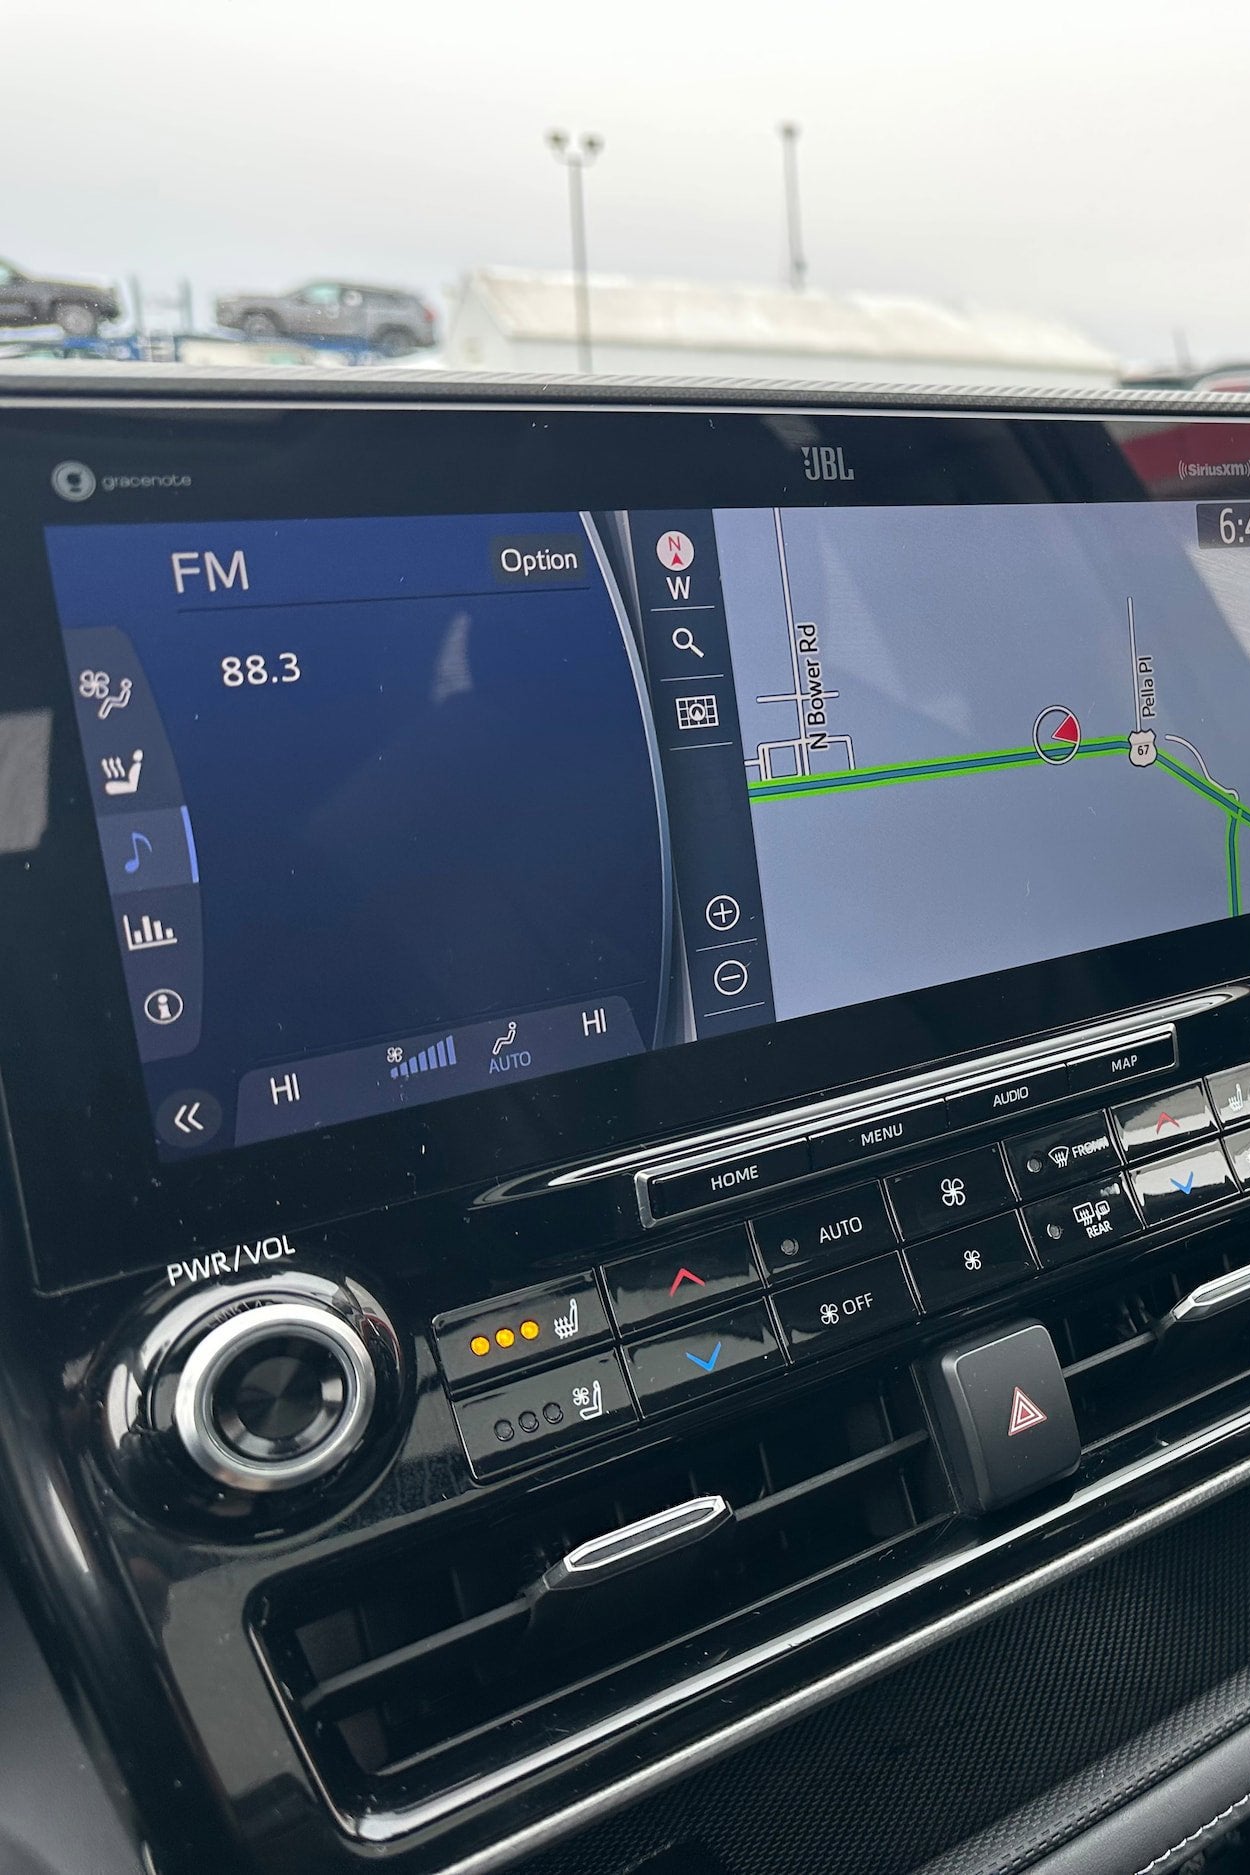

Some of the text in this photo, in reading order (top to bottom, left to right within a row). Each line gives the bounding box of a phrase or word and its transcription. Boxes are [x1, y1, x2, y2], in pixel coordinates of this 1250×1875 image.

[801, 447, 854, 480] JBL
[101, 474, 192, 491] gracenote
[668, 536, 681, 551] N
[171, 551, 249, 593] FM
[500, 548, 578, 574] Option
[667, 576, 691, 600] W
[221, 653, 301, 686] 88.3
[797, 622, 828, 749] N Bower Rd
[1140, 677, 1156, 718] Pella
[1137, 744, 1149, 756] 67
[582, 1009, 607, 1036] HI
[489, 1051, 532, 1074] AUTO
[1111, 1055, 1138, 1073] MAP
[270, 1073, 301, 1104] HI
[993, 1087, 1030, 1108] AUDIO
[861, 1123, 903, 1147] MENU
[710, 1165, 761, 1190] HOME
[818, 1216, 864, 1245] AUTO
[1086, 1220, 1113, 1238] REAR
[842, 1290, 874, 1314] OFF
